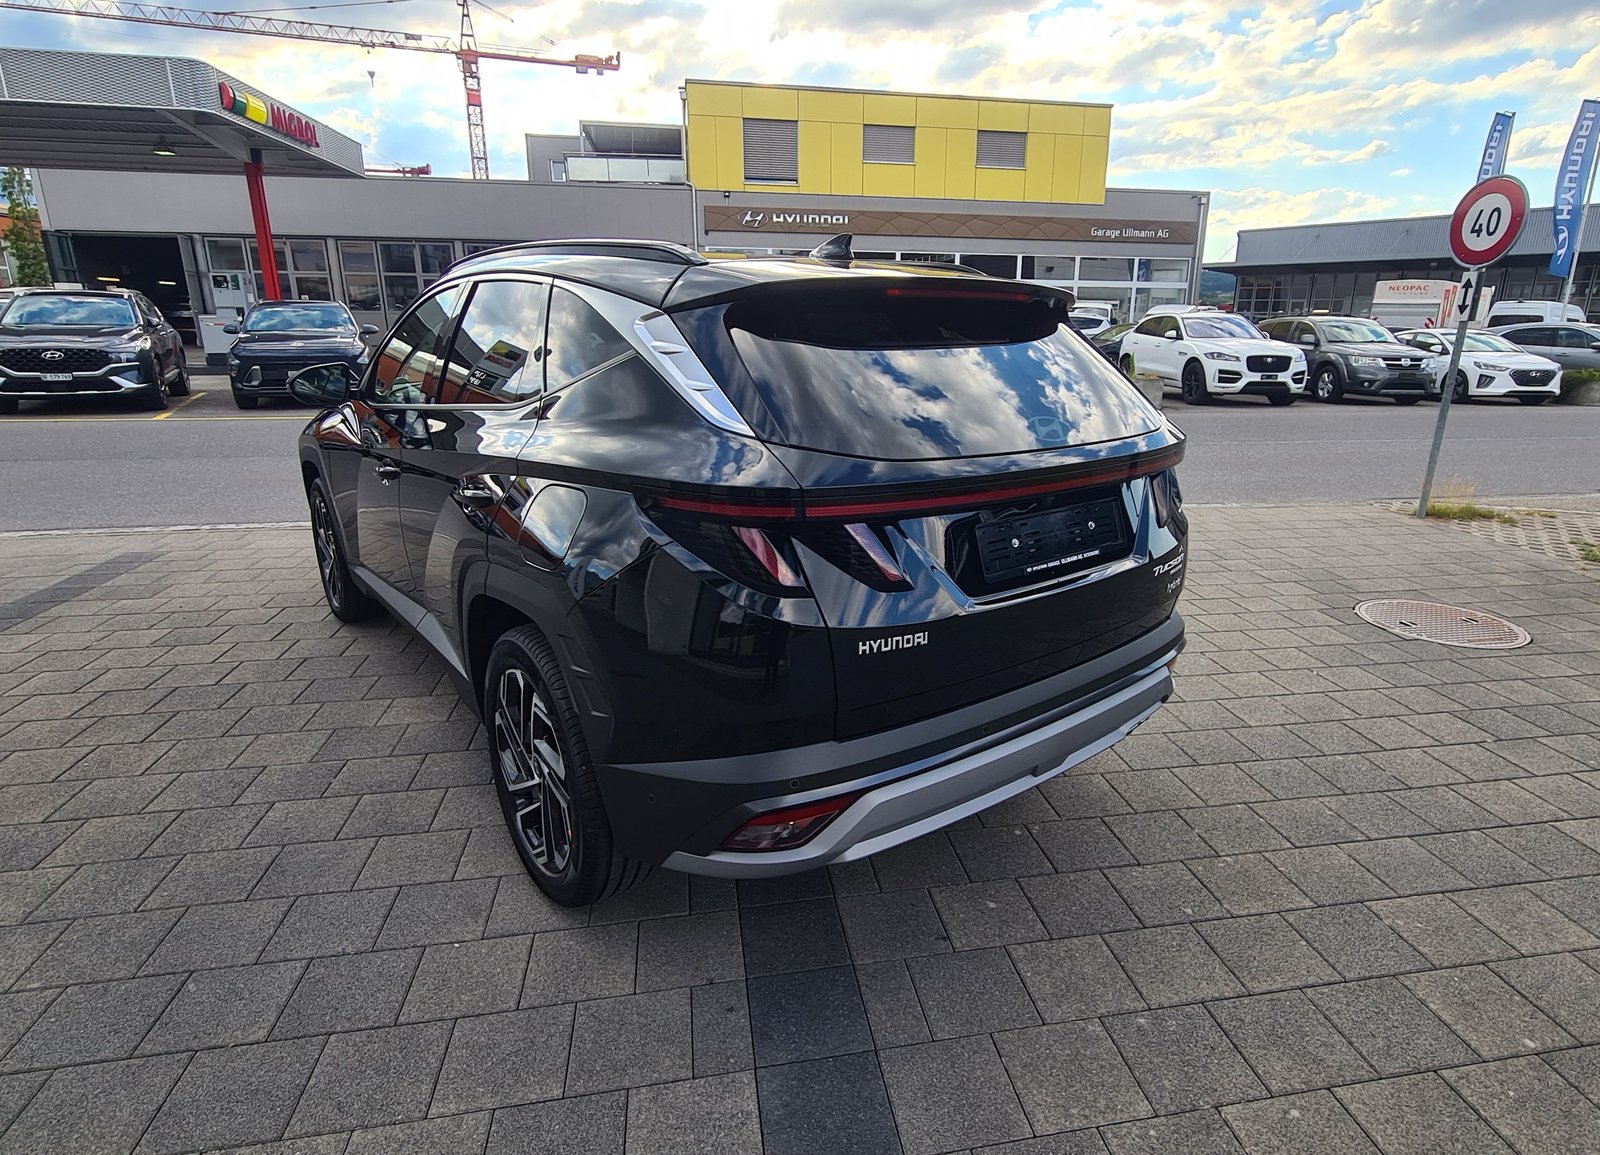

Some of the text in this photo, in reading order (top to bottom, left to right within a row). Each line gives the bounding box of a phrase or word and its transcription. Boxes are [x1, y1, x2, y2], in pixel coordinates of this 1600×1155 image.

[270, 102, 320, 148] MIGROL
[772, 213, 849, 225] HYUNDAI
[1470, 206, 1502, 238] 40
[1091, 227, 1170, 239] Garage Ullmann AG
[1388, 284, 1430, 292] NEOPAC
[1153, 552, 1184, 577] TUCSON
[858, 631, 929, 655] HYUNDAI
